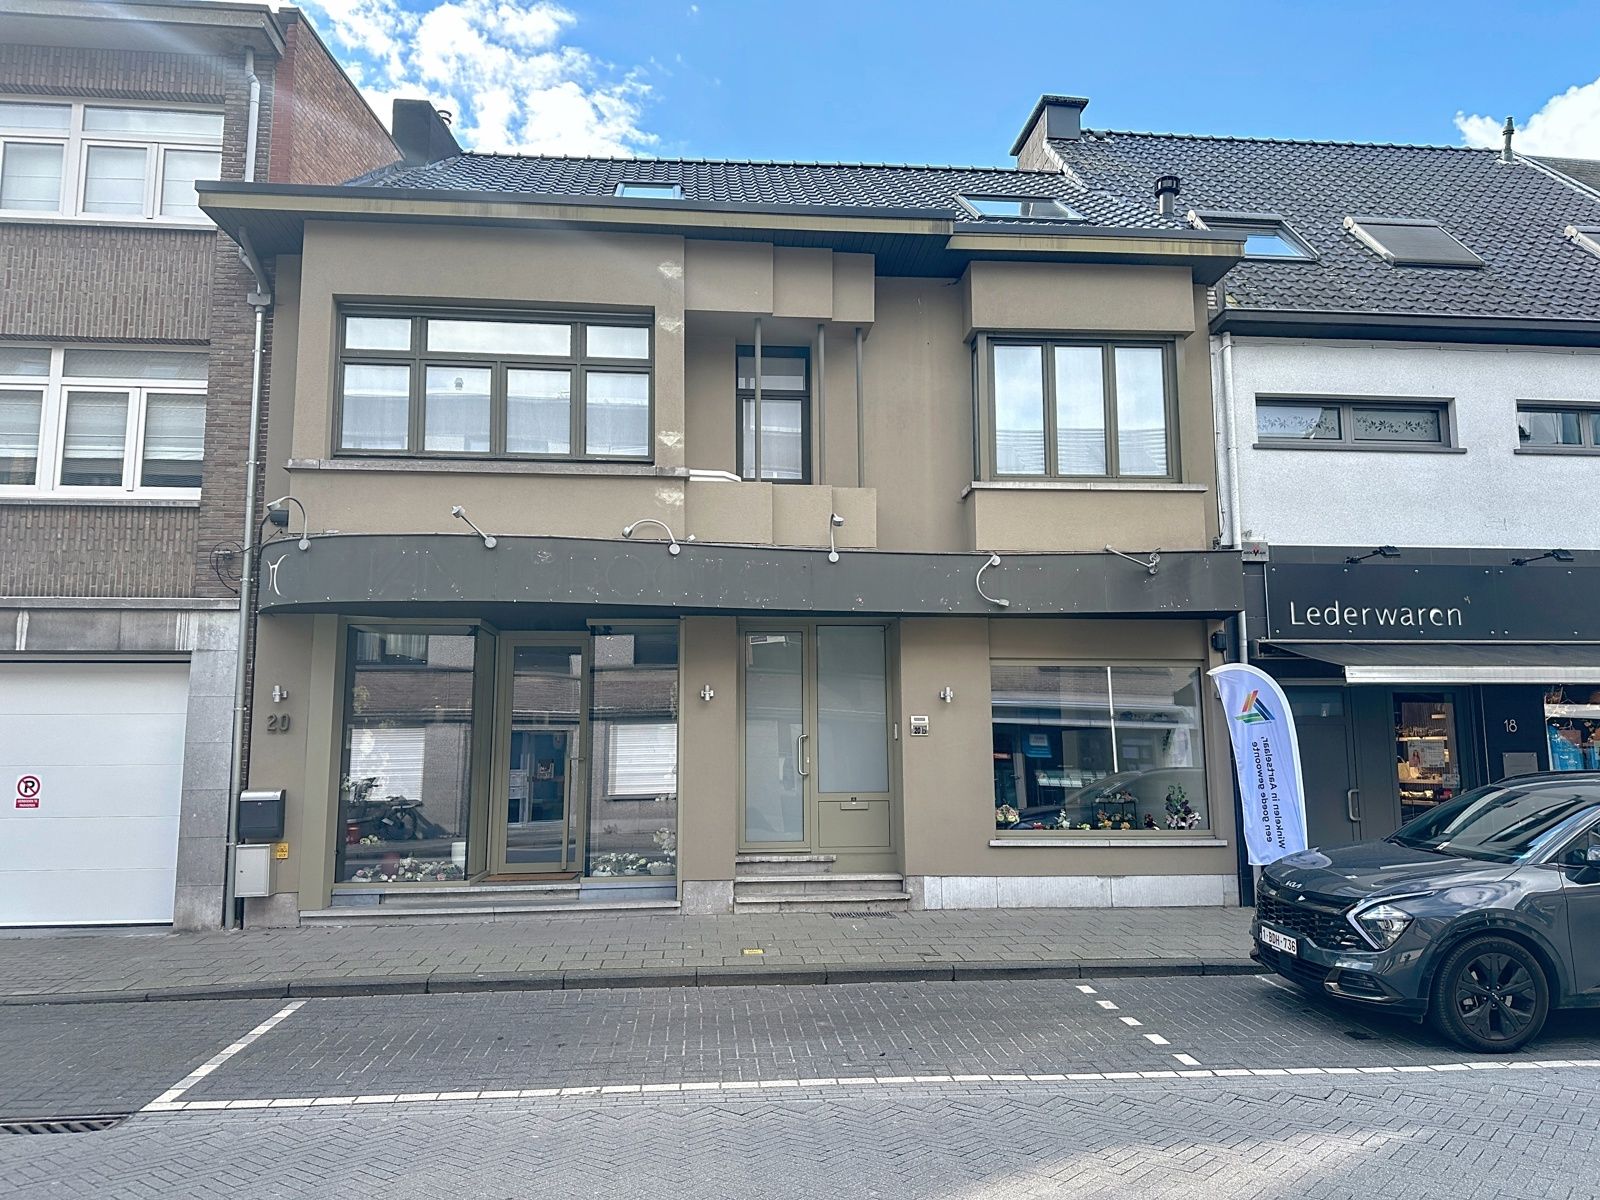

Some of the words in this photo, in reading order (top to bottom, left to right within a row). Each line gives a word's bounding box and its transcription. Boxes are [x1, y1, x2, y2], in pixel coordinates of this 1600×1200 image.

[1290, 600, 1462, 626] Lederwaren
[266, 713, 290, 732] 20
[1503, 719, 1518, 733] 18
